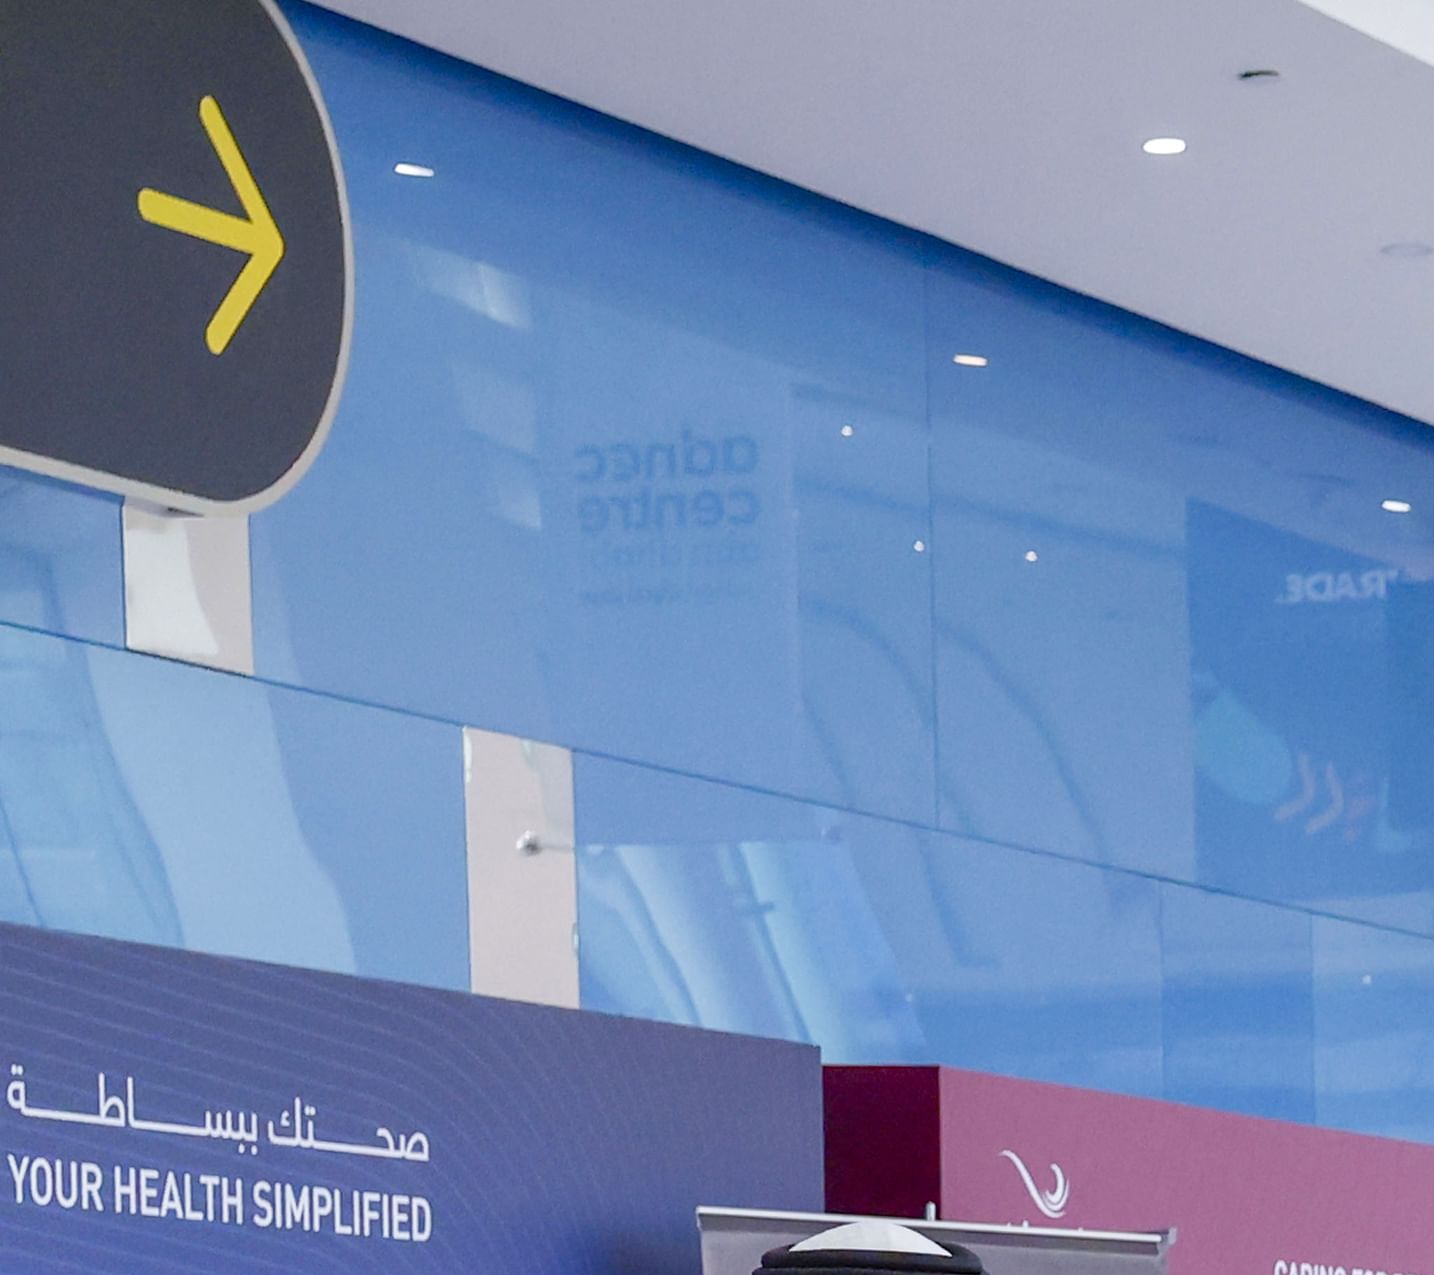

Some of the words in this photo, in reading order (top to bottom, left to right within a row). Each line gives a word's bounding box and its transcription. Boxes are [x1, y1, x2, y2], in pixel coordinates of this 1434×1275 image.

[6, 1064, 259, 1156] ببساطة
[267, 1097, 430, 1162] صحتك
[8, 1154, 104, 1212] YOUR
[114, 1164, 243, 1225] HEALTH
[253, 1180, 433, 1242] SIMPLIFIED
